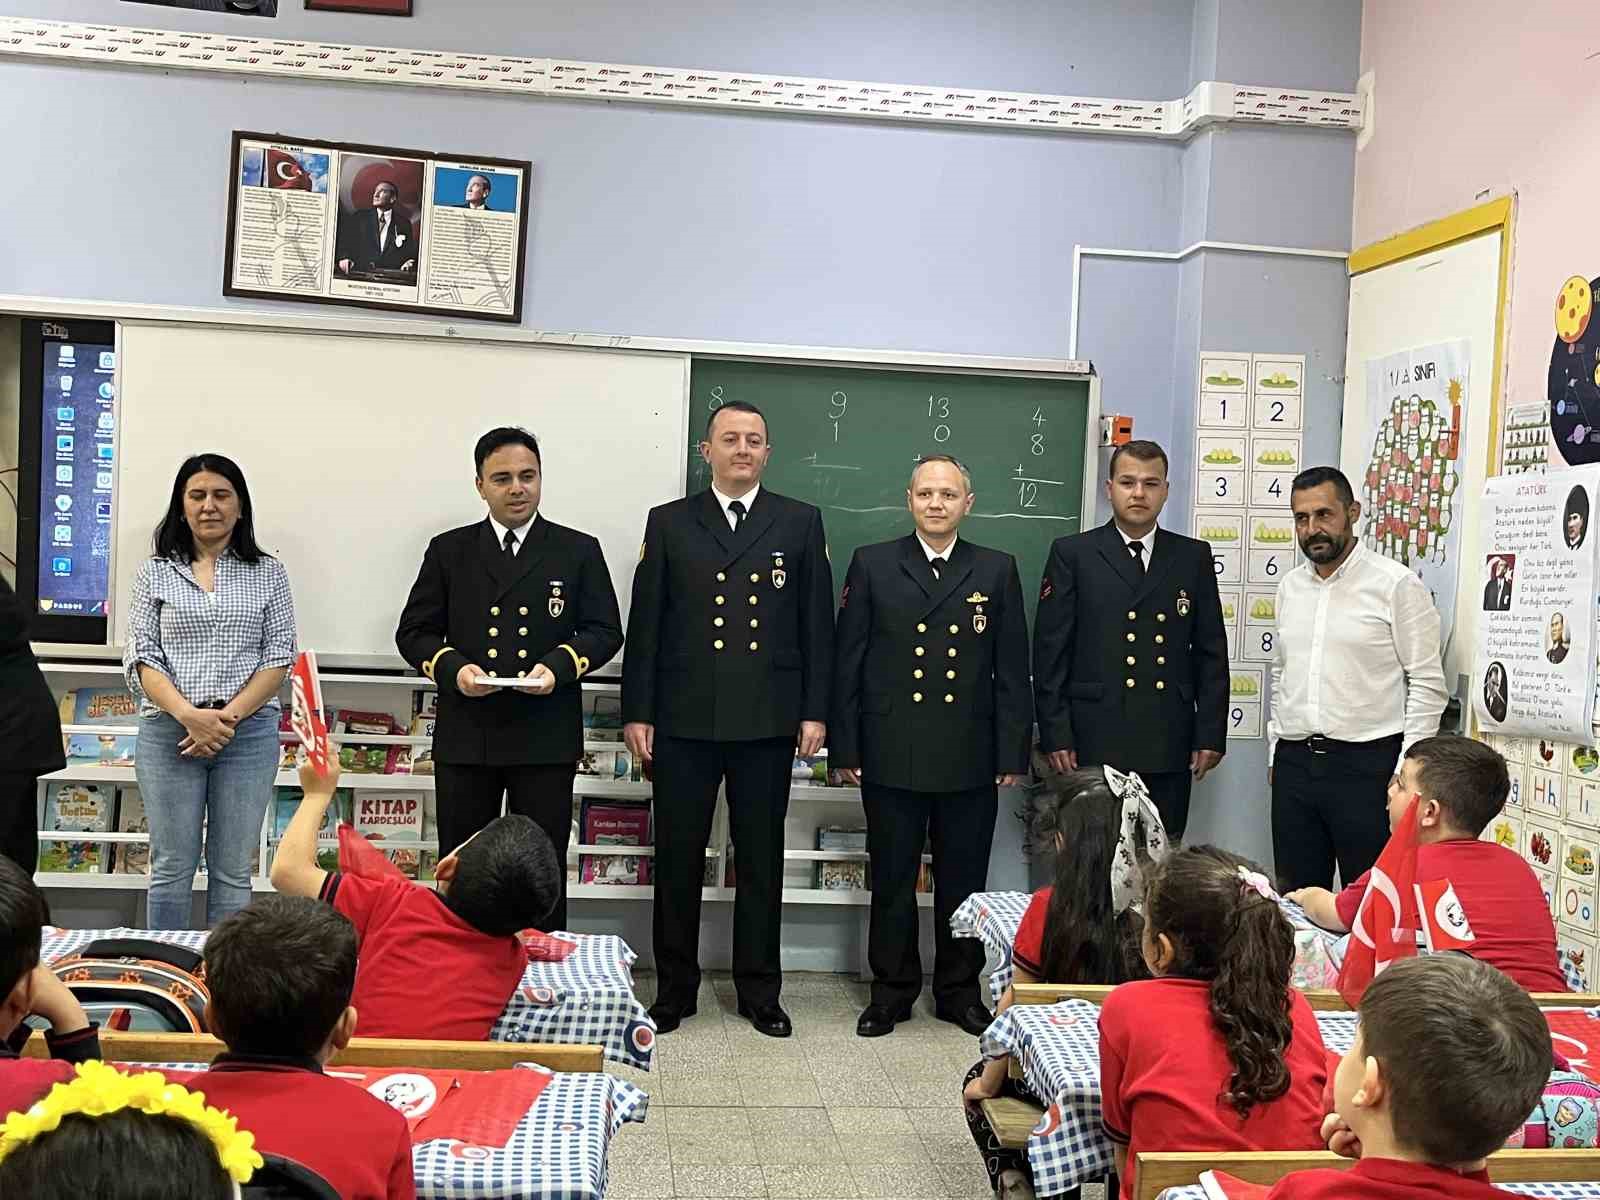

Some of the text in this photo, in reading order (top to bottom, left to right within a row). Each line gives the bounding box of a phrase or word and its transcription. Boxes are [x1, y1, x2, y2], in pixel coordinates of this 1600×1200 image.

[708, 386, 724, 411] 8
[828, 391, 848, 419] 9
[927, 394, 950, 419] 13
[1031, 406, 1046, 428] 4
[1220, 399, 1226, 420] 1
[1270, 401, 1284, 422] 2
[833, 421, 839, 442] 1
[1031, 433, 1045, 456] 8
[1018, 482, 1039, 508] 12
[1216, 476, 1227, 497] 3
[1268, 478, 1282, 498] 4
[1213, 555, 1225, 575] 5
[1266, 556, 1278, 576] 6
[1261, 632, 1273, 652] 8
[1231, 707, 1243, 728] 9
